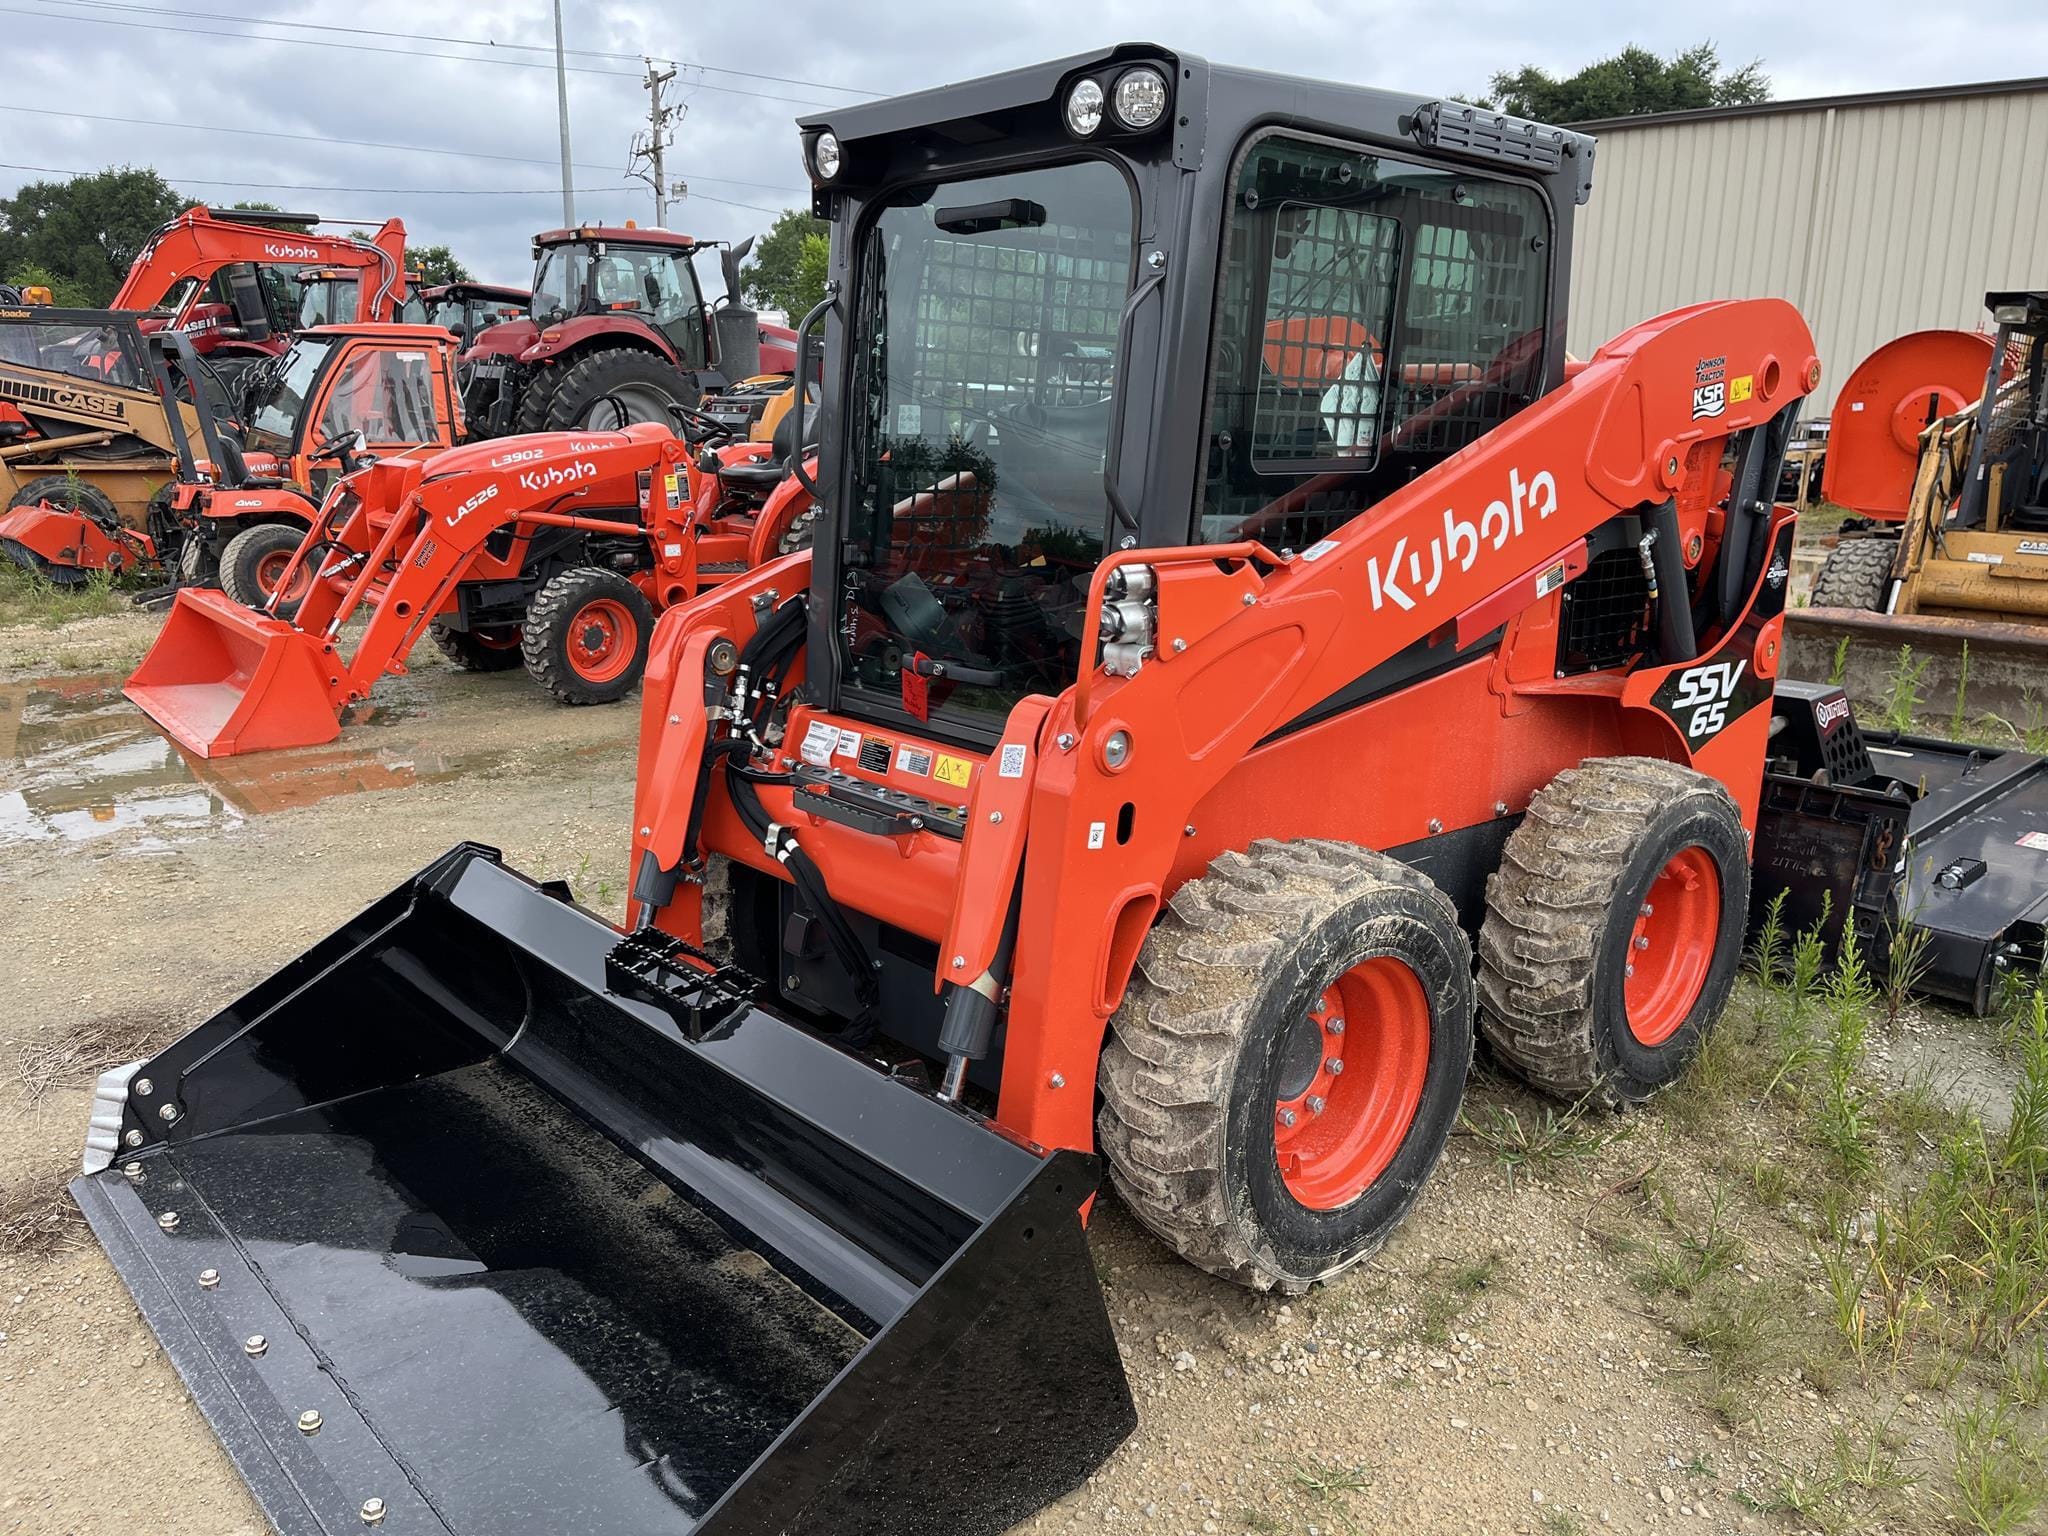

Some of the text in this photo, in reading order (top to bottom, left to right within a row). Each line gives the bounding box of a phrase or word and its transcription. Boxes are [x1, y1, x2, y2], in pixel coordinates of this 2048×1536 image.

[265, 244, 319, 259] Kubota
[182, 319, 206, 333] ASE
[1696, 357, 1726, 371] JOHNSON
[1696, 370, 1725, 383] TRACTOR
[53, 391, 120, 416] CASE
[1693, 382, 1725, 408] KSR
[249, 463, 279, 473] KUBO
[491, 448, 544, 468] L3902
[519, 460, 597, 491] Kubota
[234, 499, 263, 507] 4WD
[445, 483, 499, 527] LA526
[1366, 467, 1558, 612] Kubota
[2019, 541, 2048, 552] CAS
[1672, 659, 1748, 709] SSV
[1688, 701, 1729, 737] 65
